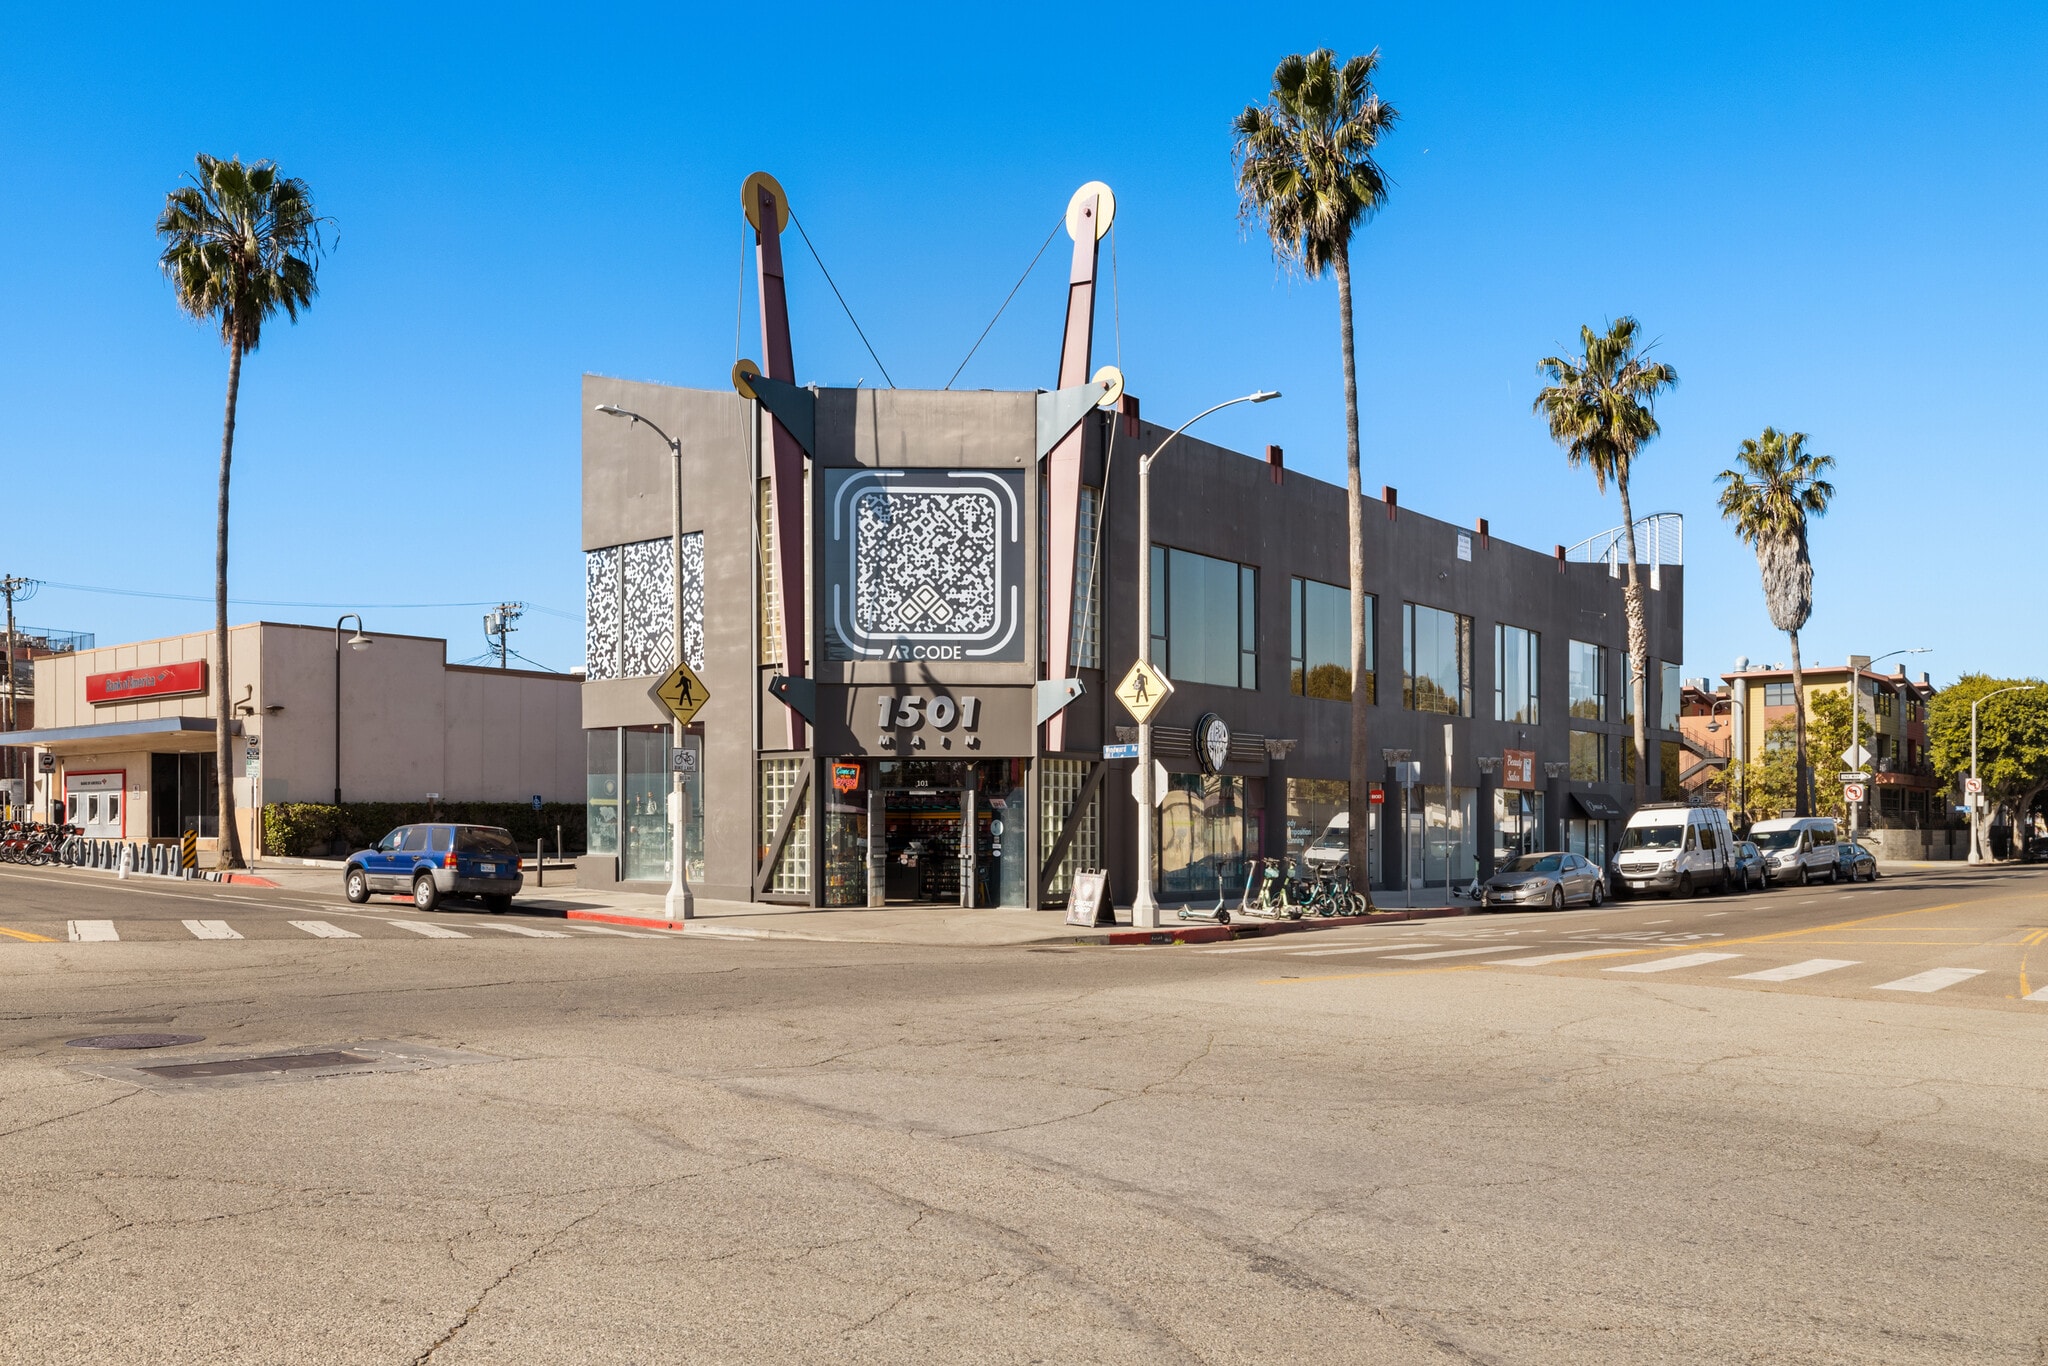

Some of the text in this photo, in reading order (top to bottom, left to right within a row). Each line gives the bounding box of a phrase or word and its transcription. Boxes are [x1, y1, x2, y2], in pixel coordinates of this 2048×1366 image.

[887, 645, 962, 660] AR CODE
[106, 678, 121, 692] Bank
[129, 673, 155, 689] America
[878, 695, 976, 729] 1501
[1507, 755, 1523, 769] Beauty
[1507, 770, 1520, 782] Salon
[1287, 819, 1296, 828] ody
